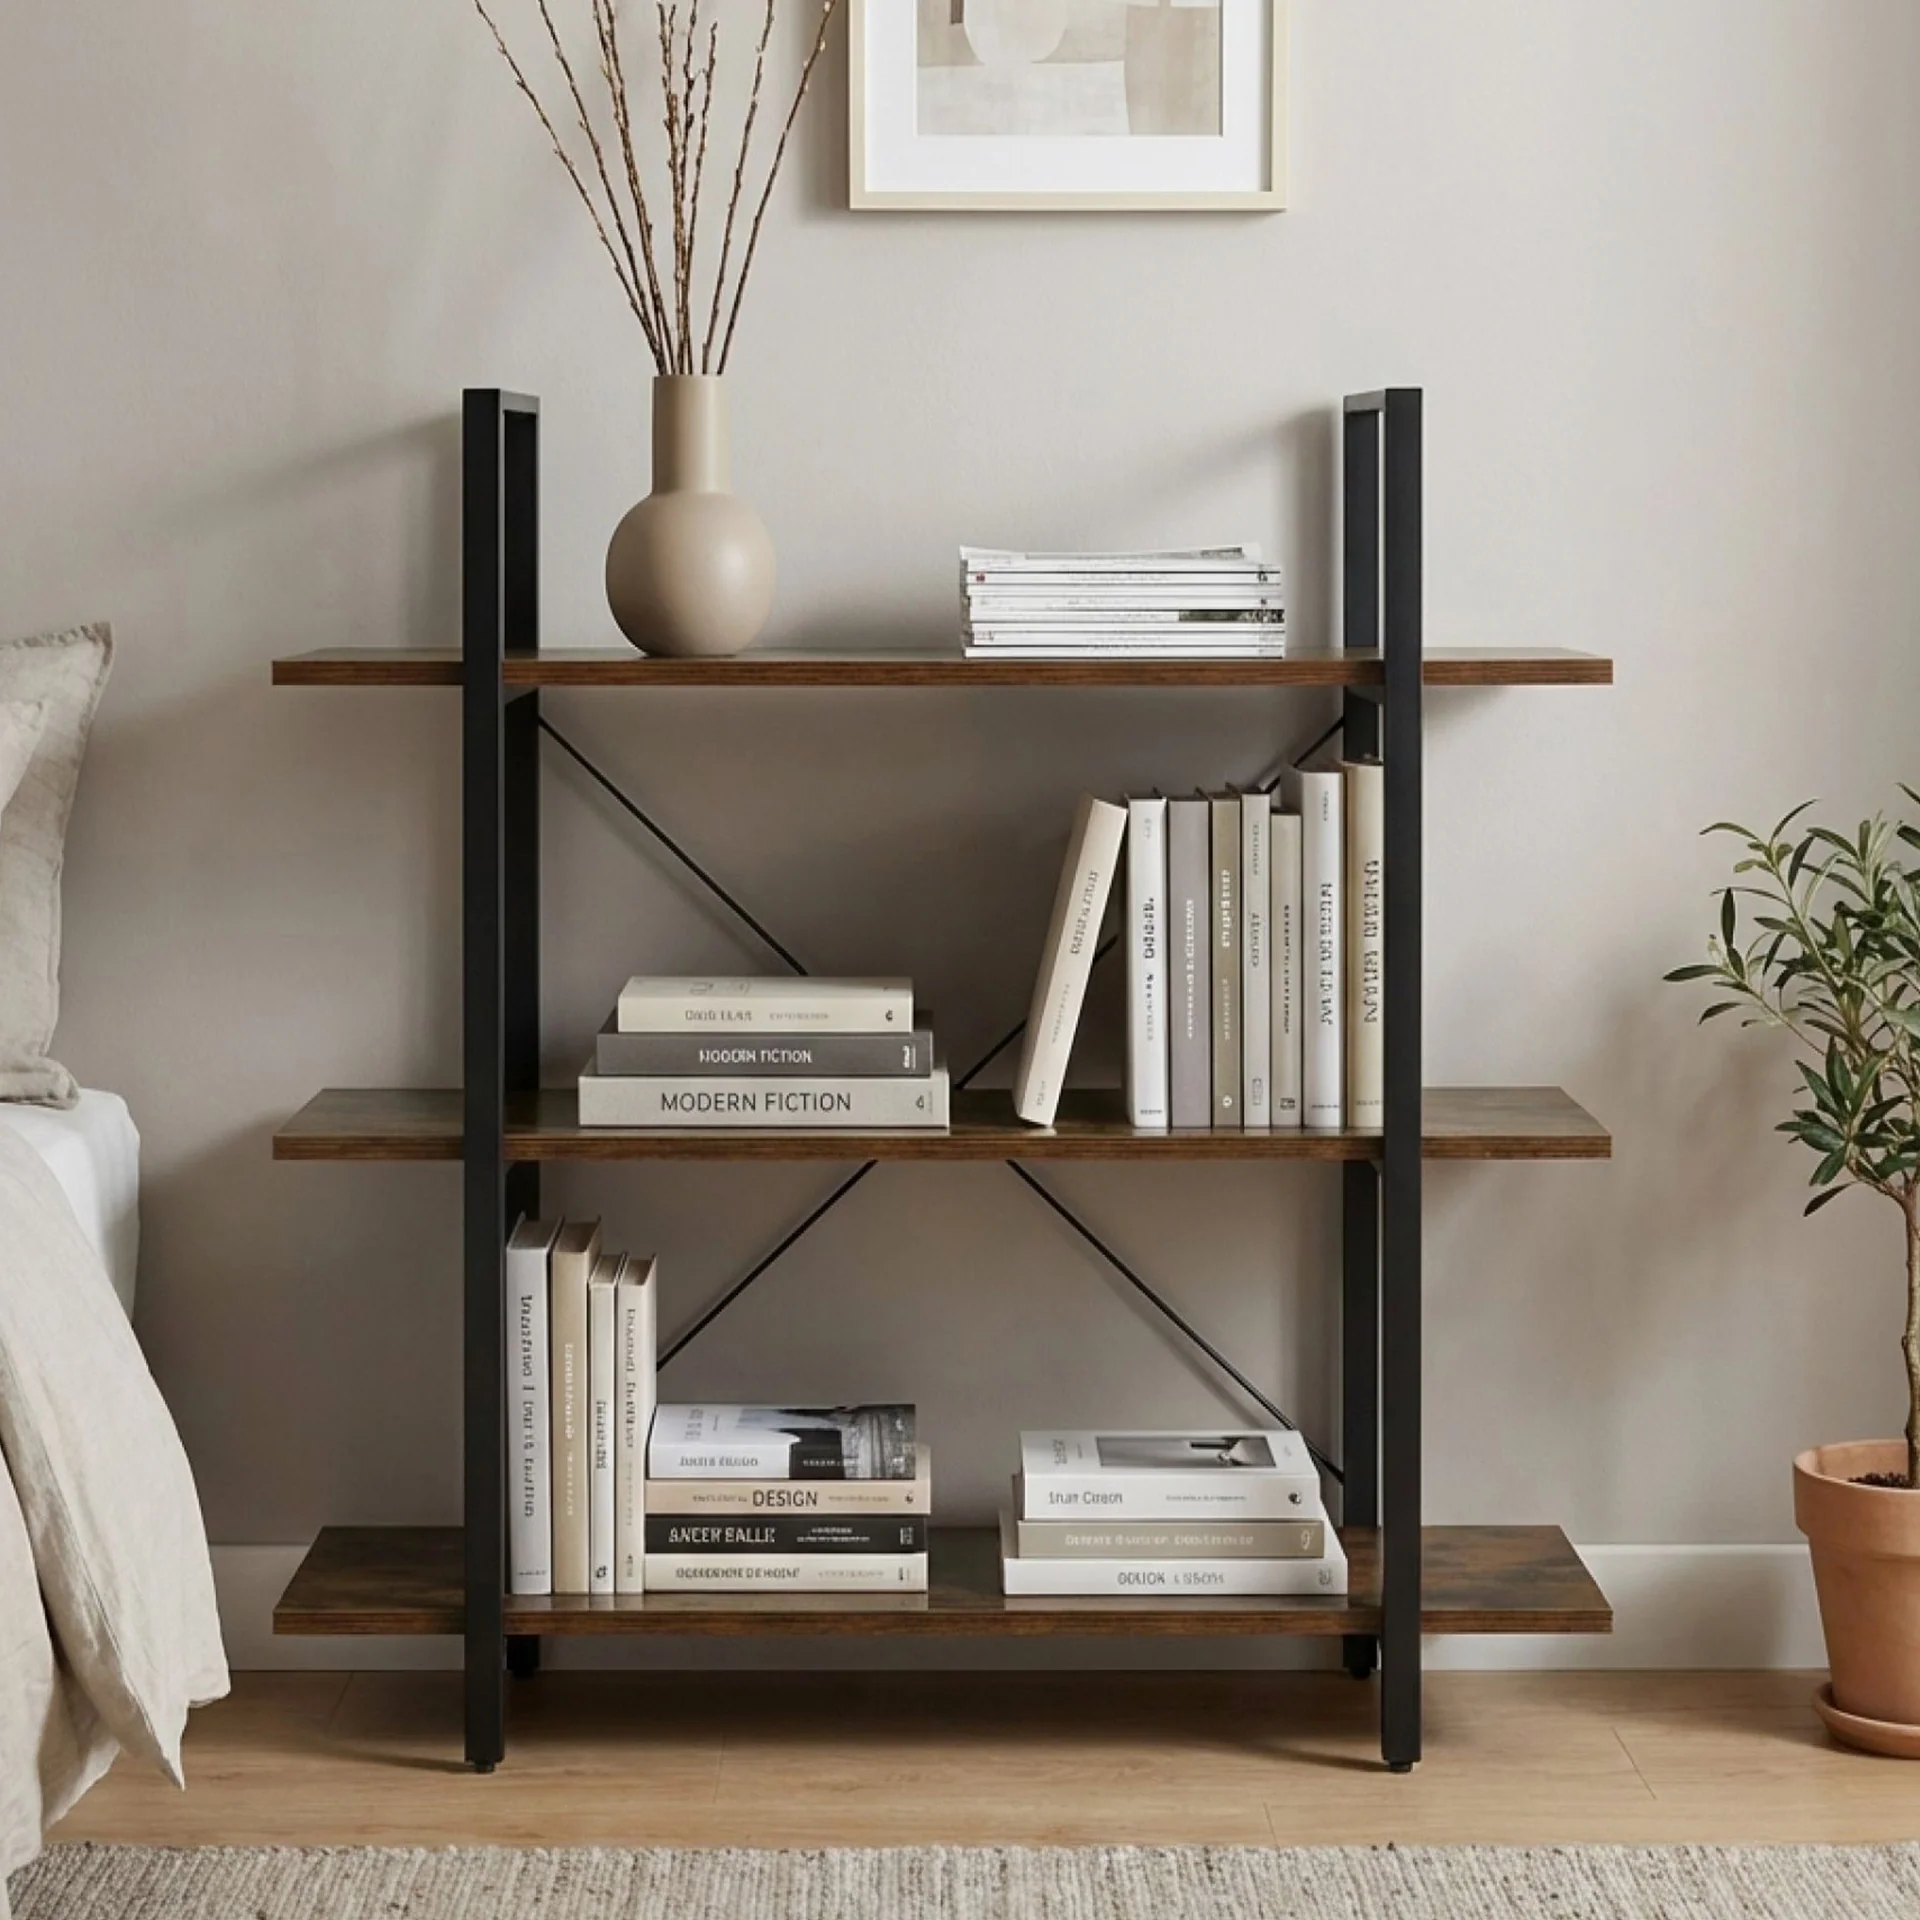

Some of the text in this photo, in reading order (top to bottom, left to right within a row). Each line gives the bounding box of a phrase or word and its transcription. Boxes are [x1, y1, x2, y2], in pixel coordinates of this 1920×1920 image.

[661, 1092, 851, 1112] MODERN FICTION
[752, 1489, 818, 1508] DESIGN
